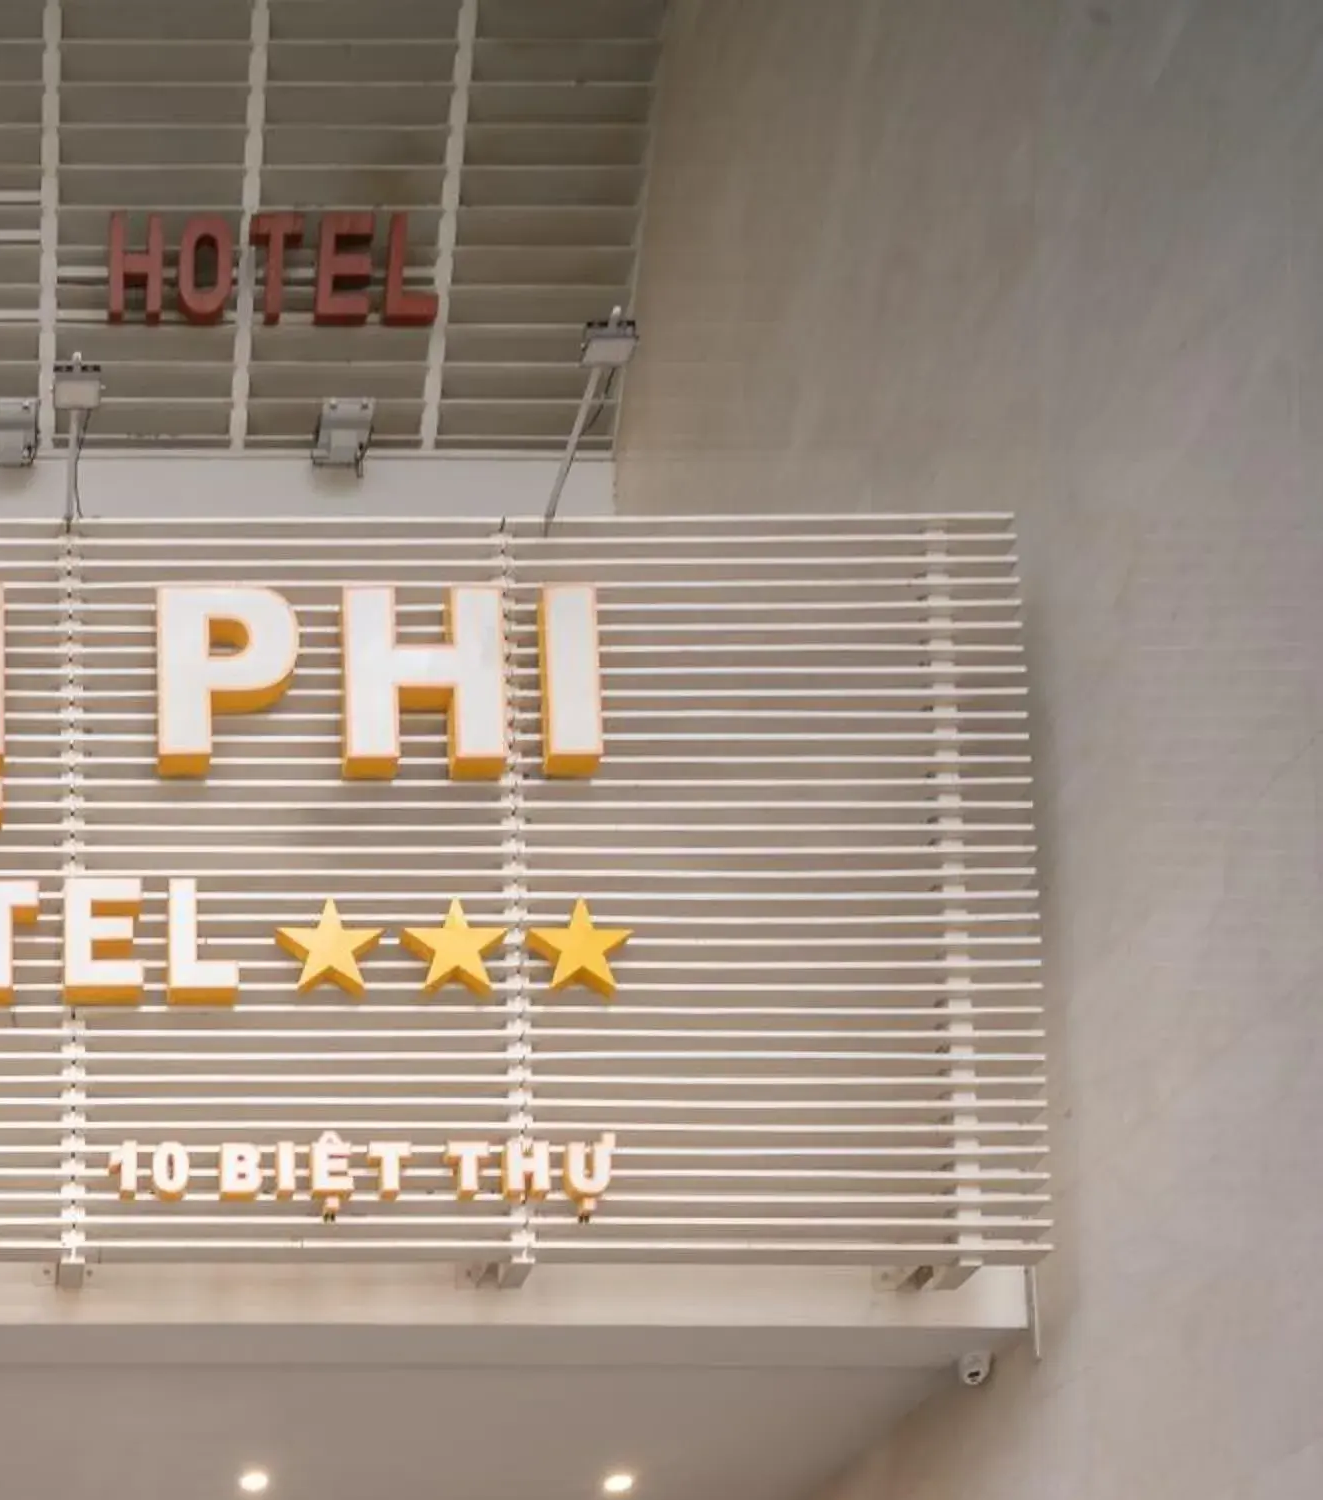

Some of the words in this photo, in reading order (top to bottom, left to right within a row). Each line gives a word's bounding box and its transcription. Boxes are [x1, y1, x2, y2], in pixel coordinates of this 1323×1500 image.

[107, 210, 439, 327] HOTEL
[155, 583, 601, 780] PHI
[109, 1139, 190, 1201] 10
[219, 1130, 413, 1213] BIỆT
